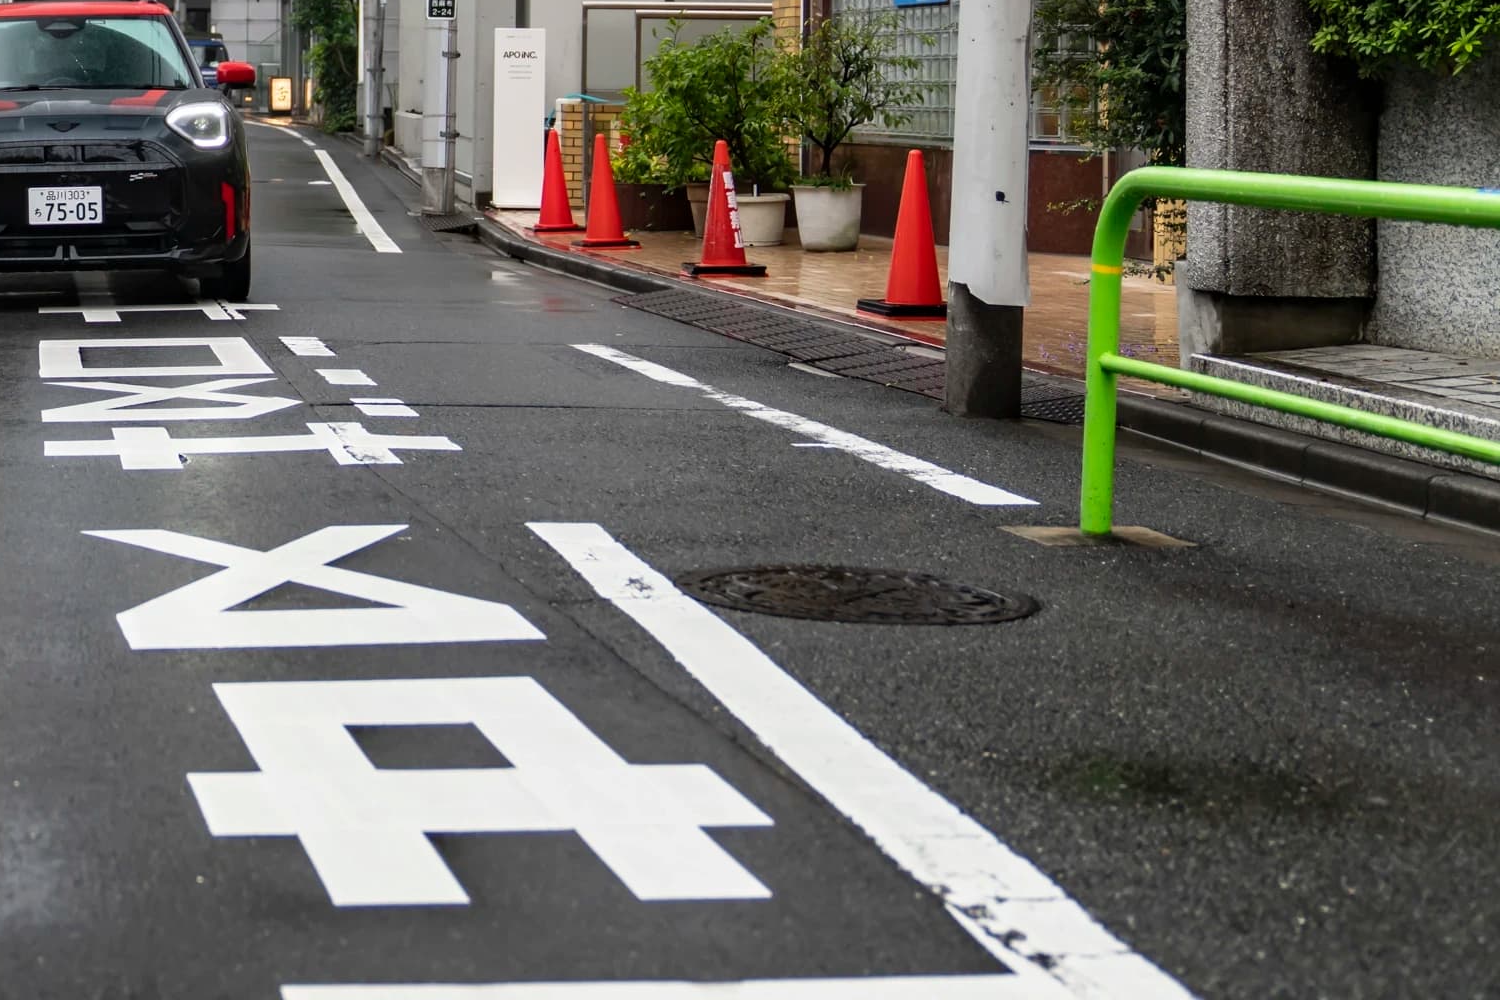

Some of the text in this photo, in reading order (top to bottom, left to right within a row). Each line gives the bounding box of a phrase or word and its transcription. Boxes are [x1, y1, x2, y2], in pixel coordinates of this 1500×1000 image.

[431, 8, 452, 16] 2-24
[503, 51, 520, 59] APO
[34, 202, 98, 222] ち 75-05
